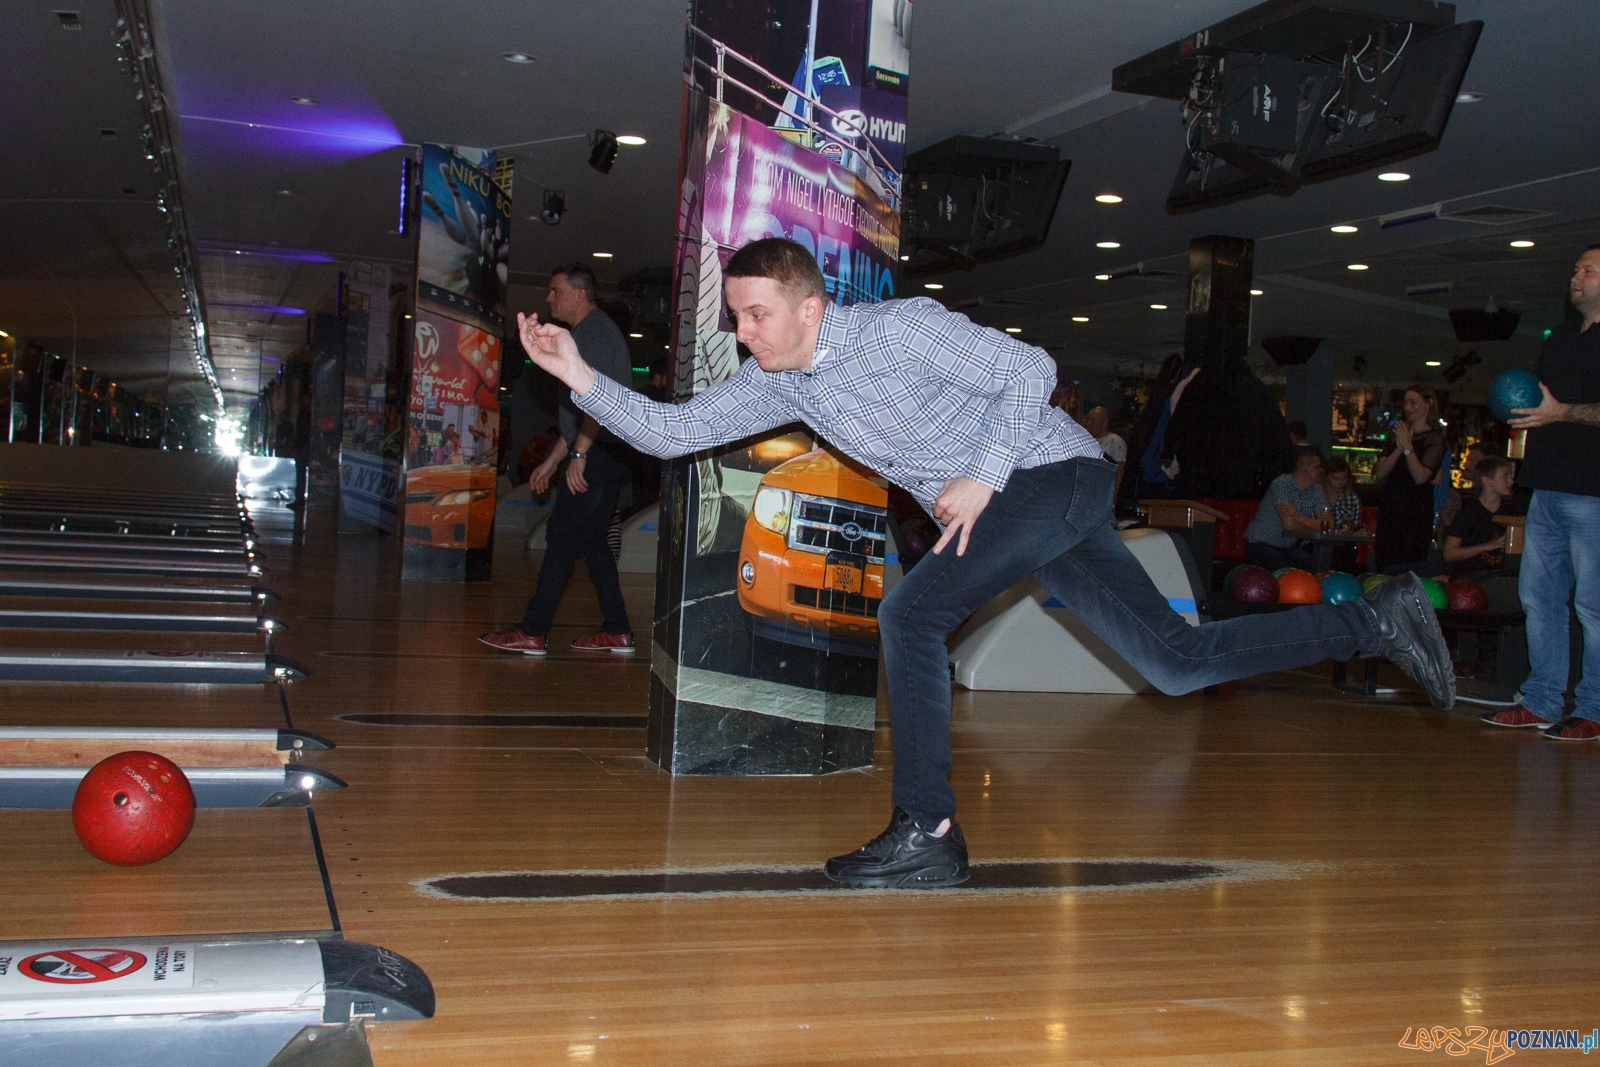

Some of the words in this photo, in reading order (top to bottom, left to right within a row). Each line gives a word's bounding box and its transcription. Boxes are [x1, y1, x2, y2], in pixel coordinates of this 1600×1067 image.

[1262, 84, 1271, 122] AMF
[450, 158, 491, 197] NIKU
[752, 157, 784, 202] FROM
[786, 171, 815, 213] NIGEL
[353, 467, 397, 499] NYPD
[172, 963, 186, 972] NA
[173, 950, 187, 962] TORY
